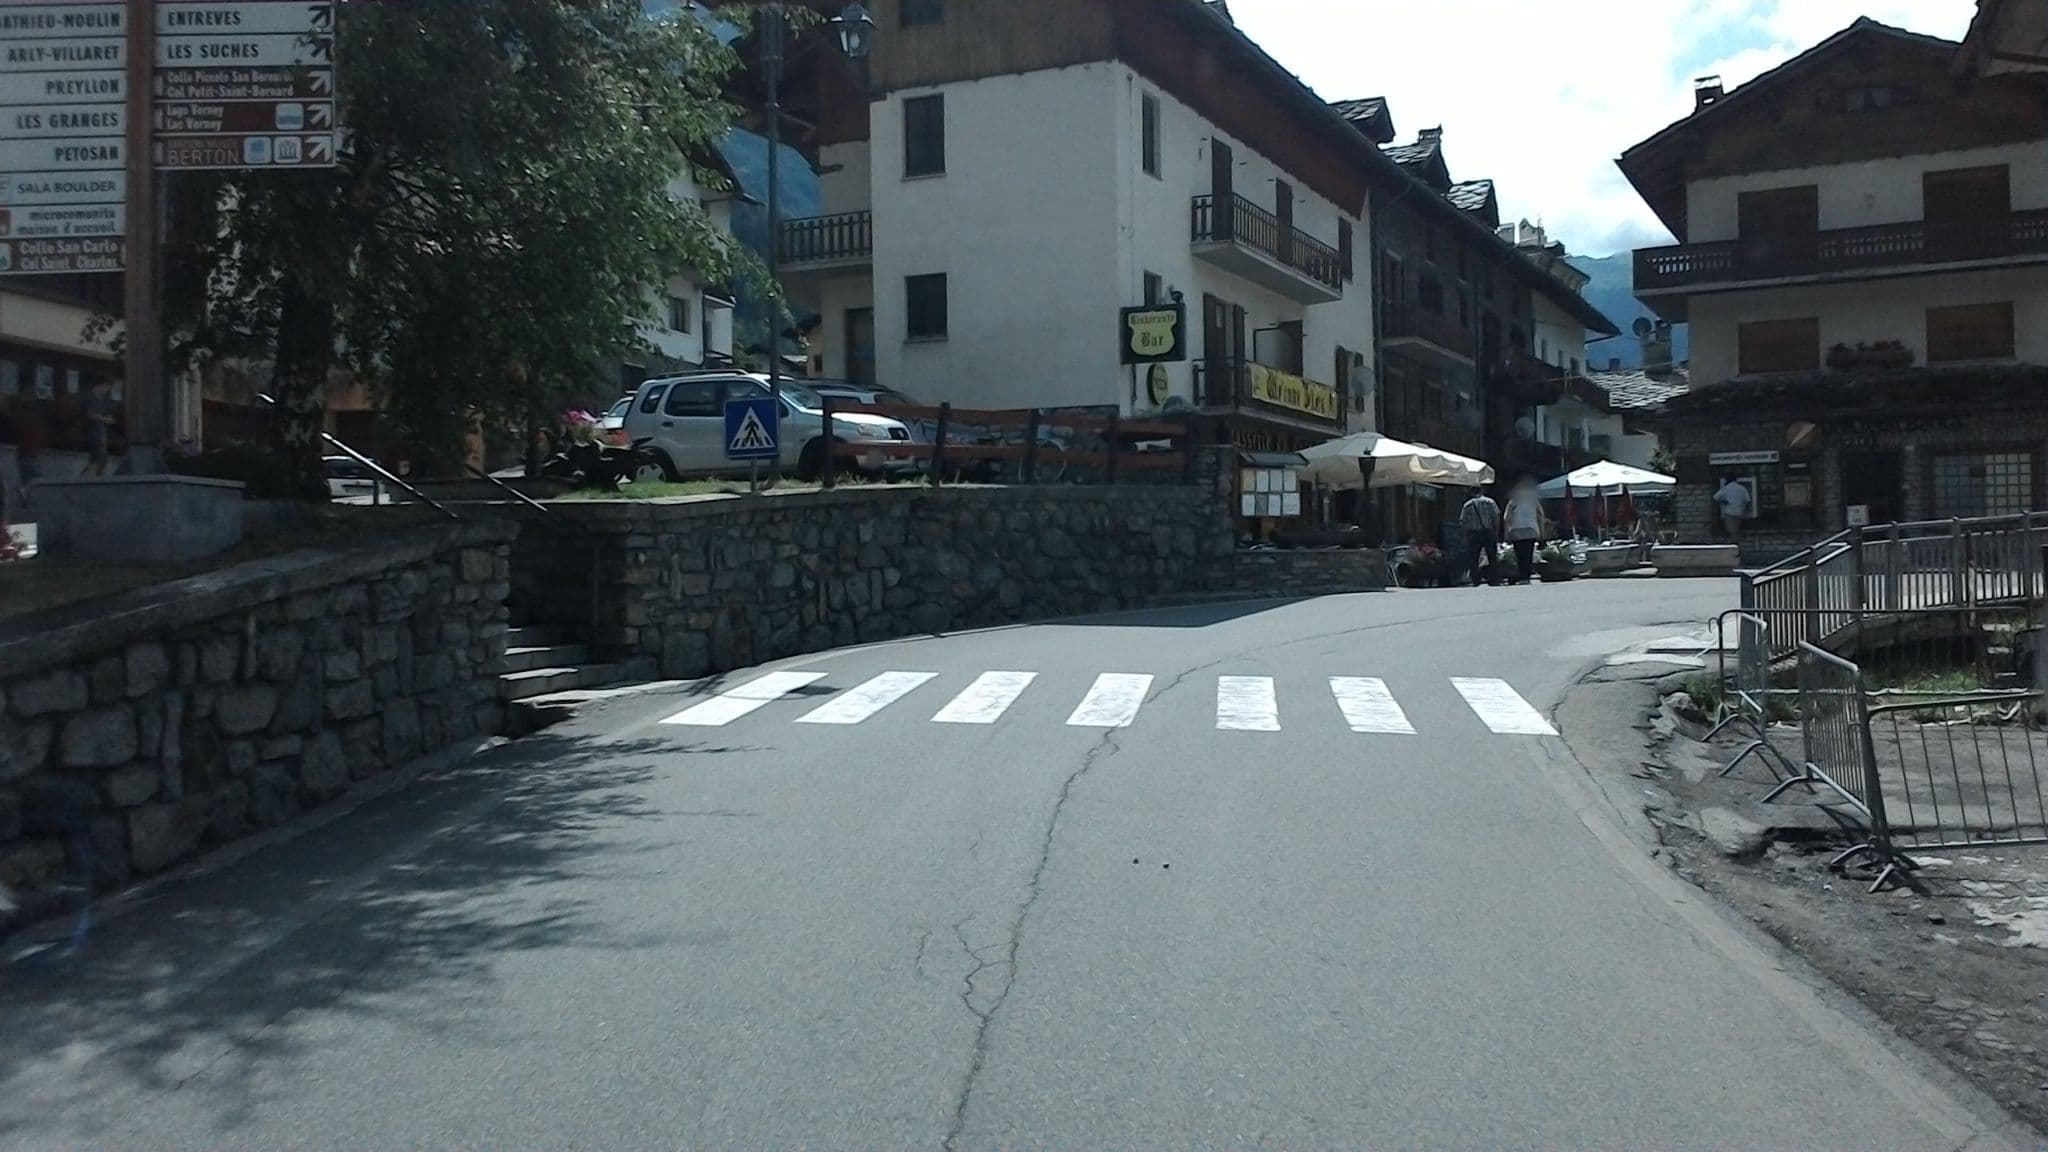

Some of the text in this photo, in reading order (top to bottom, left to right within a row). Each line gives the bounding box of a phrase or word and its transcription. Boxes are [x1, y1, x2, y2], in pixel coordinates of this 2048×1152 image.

[168, 11, 241, 26] ENTREVES
[8, 46, 120, 62] ARLY-VILLARET
[167, 43, 259, 59] LES SUCHES
[46, 79, 119, 95] PREYLLON
[17, 112, 119, 129] LES GRANGES
[55, 146, 118, 162] PETOSAN
[167, 149, 241, 165] BERTON
[17, 180, 116, 194] SALA BOULDER
[1141, 331, 1164, 348] Bar
